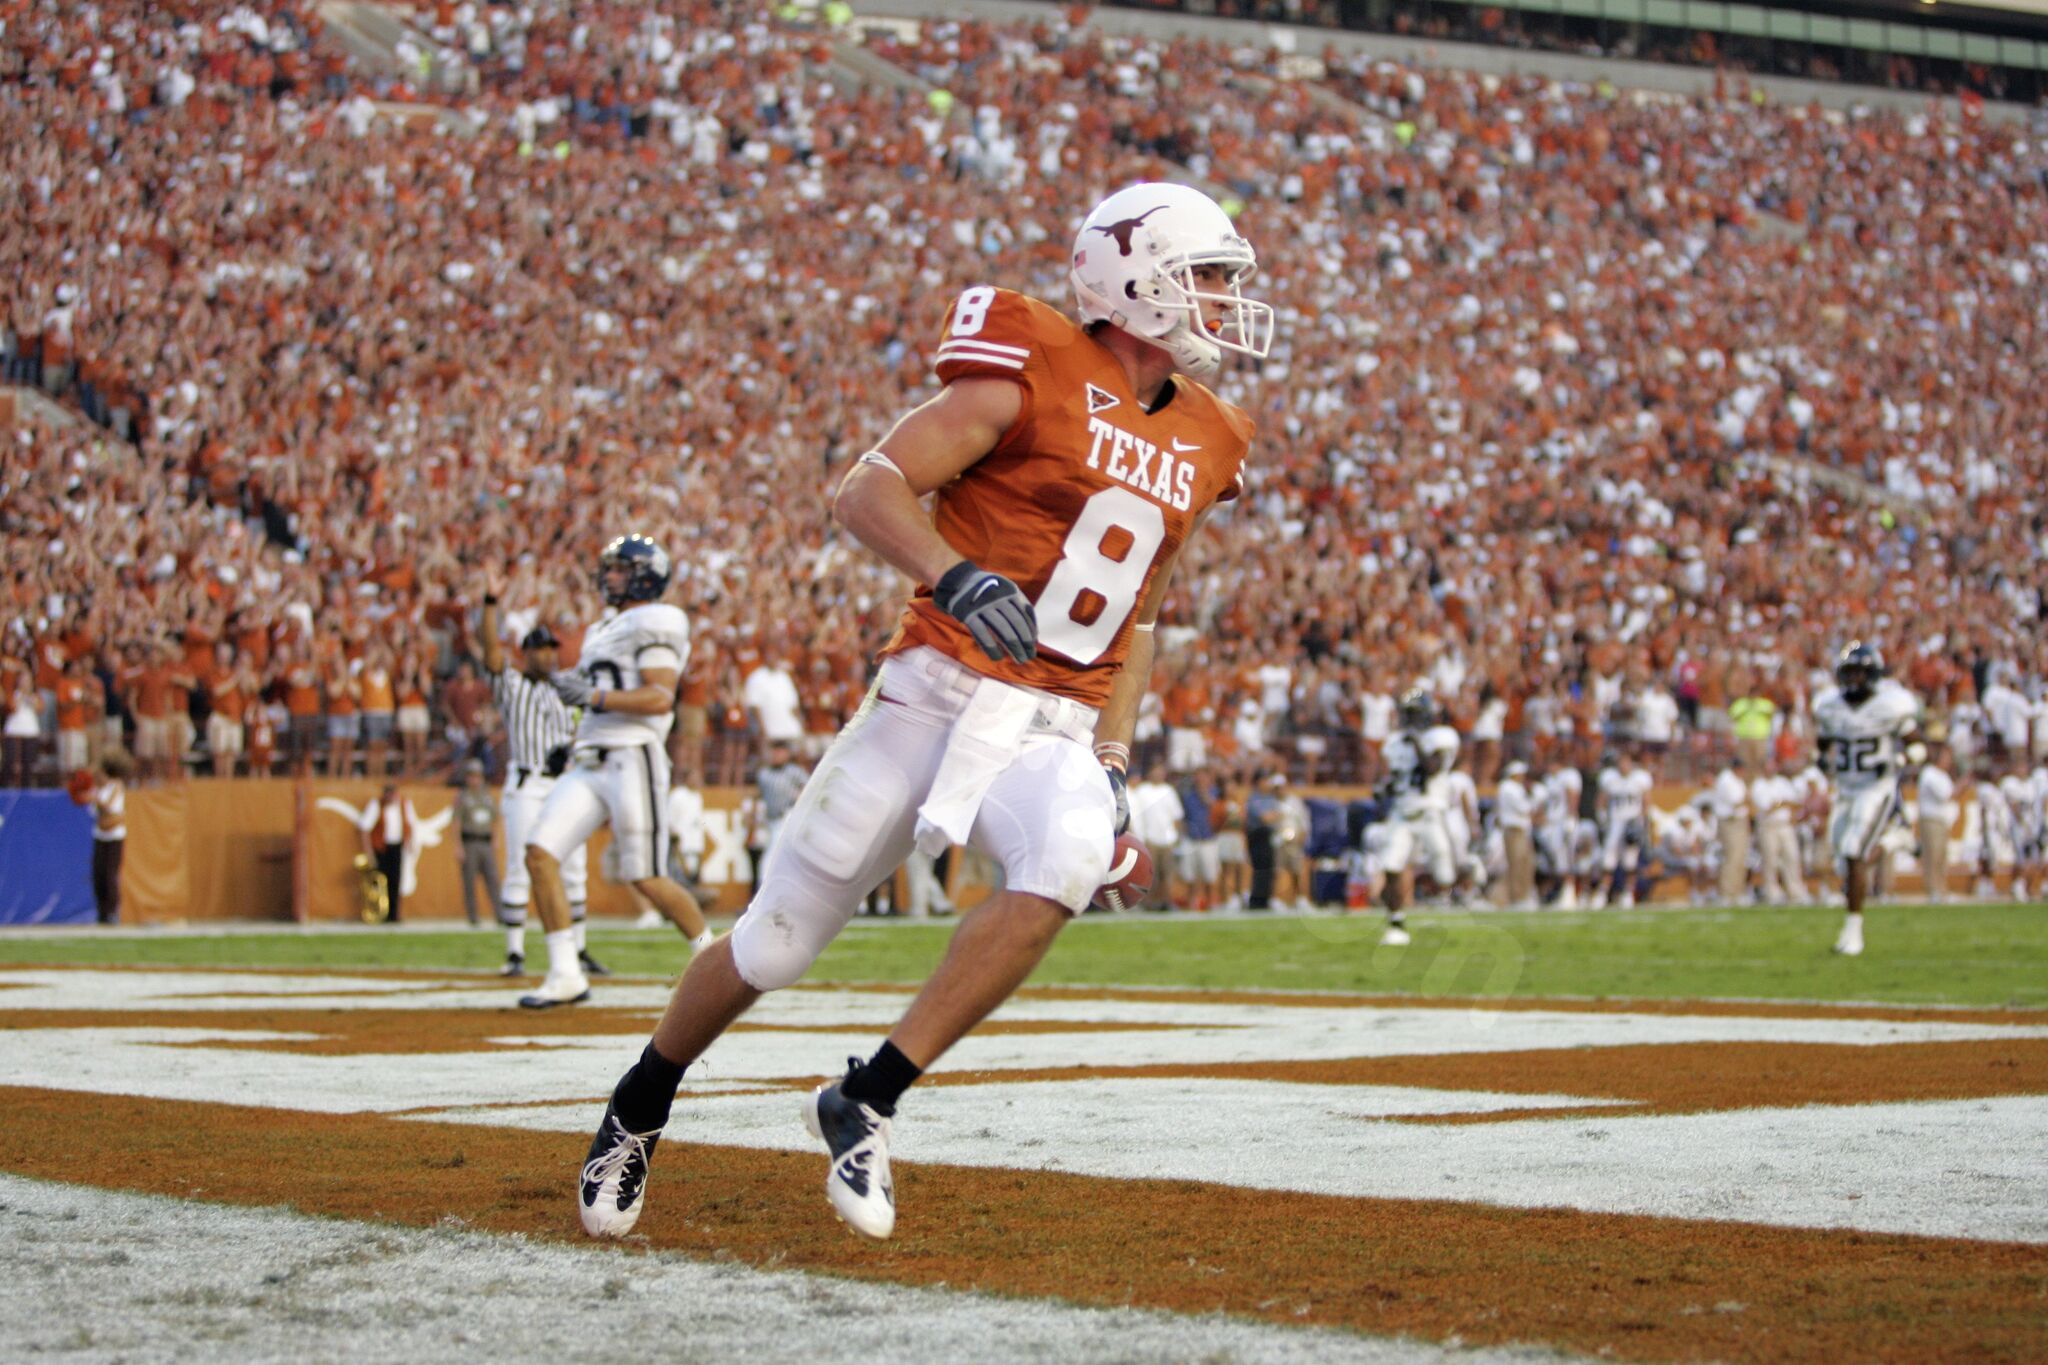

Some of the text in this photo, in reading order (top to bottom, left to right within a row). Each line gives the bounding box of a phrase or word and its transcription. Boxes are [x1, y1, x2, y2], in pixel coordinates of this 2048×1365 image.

[951, 286, 996, 337] 8
[1086, 416, 1195, 512] TEXAS
[1034, 485, 1165, 665] 8
